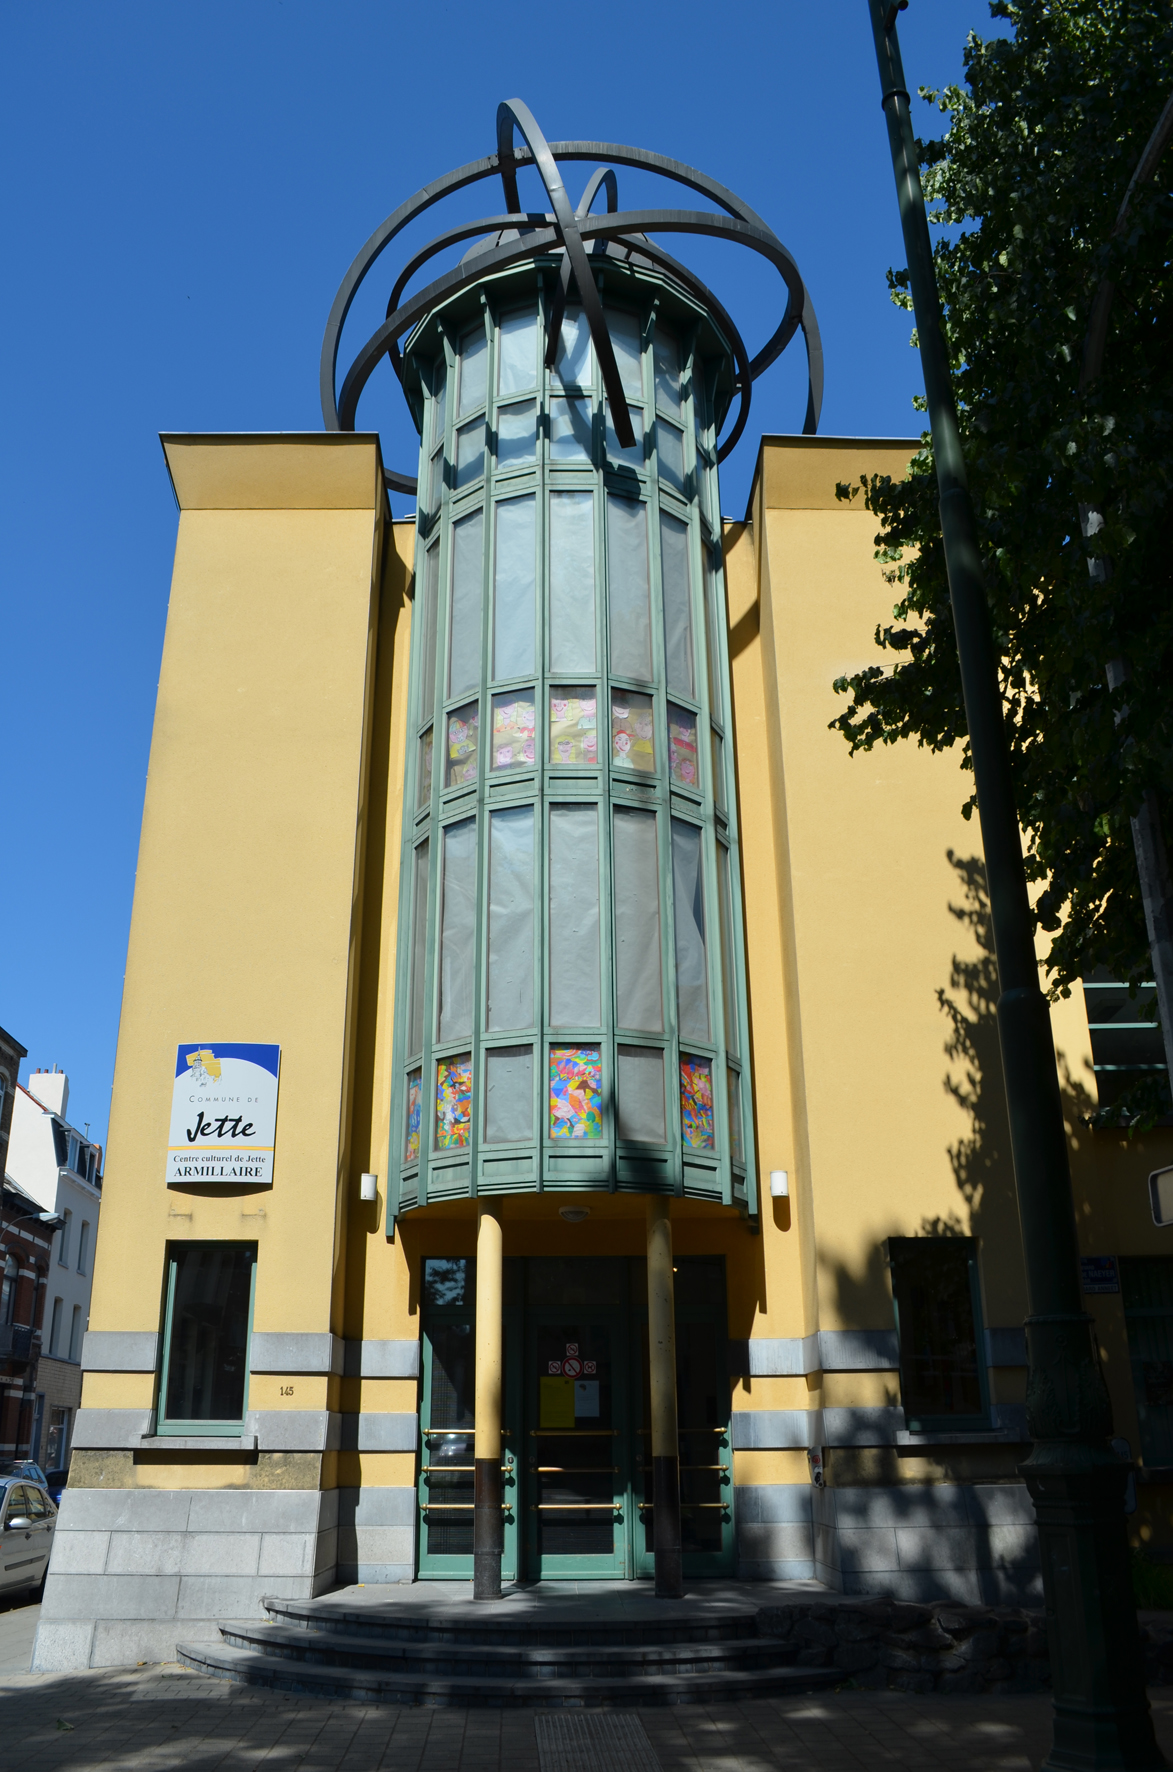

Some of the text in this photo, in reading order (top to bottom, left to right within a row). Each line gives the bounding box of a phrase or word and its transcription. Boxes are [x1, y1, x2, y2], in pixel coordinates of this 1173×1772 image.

[188, 1095, 241, 1103] COMMUNE
[186, 1111, 257, 1142] Jette
[173, 1155, 200, 1163] Centre
[201, 1154, 233, 1162] culturel
[245, 1155, 266, 1163] Jette
[173, 1166, 263, 1177] ARMILLAIRE
[1088, 1269, 1115, 1278] NAEYER
[280, 1386, 294, 1396] 145
